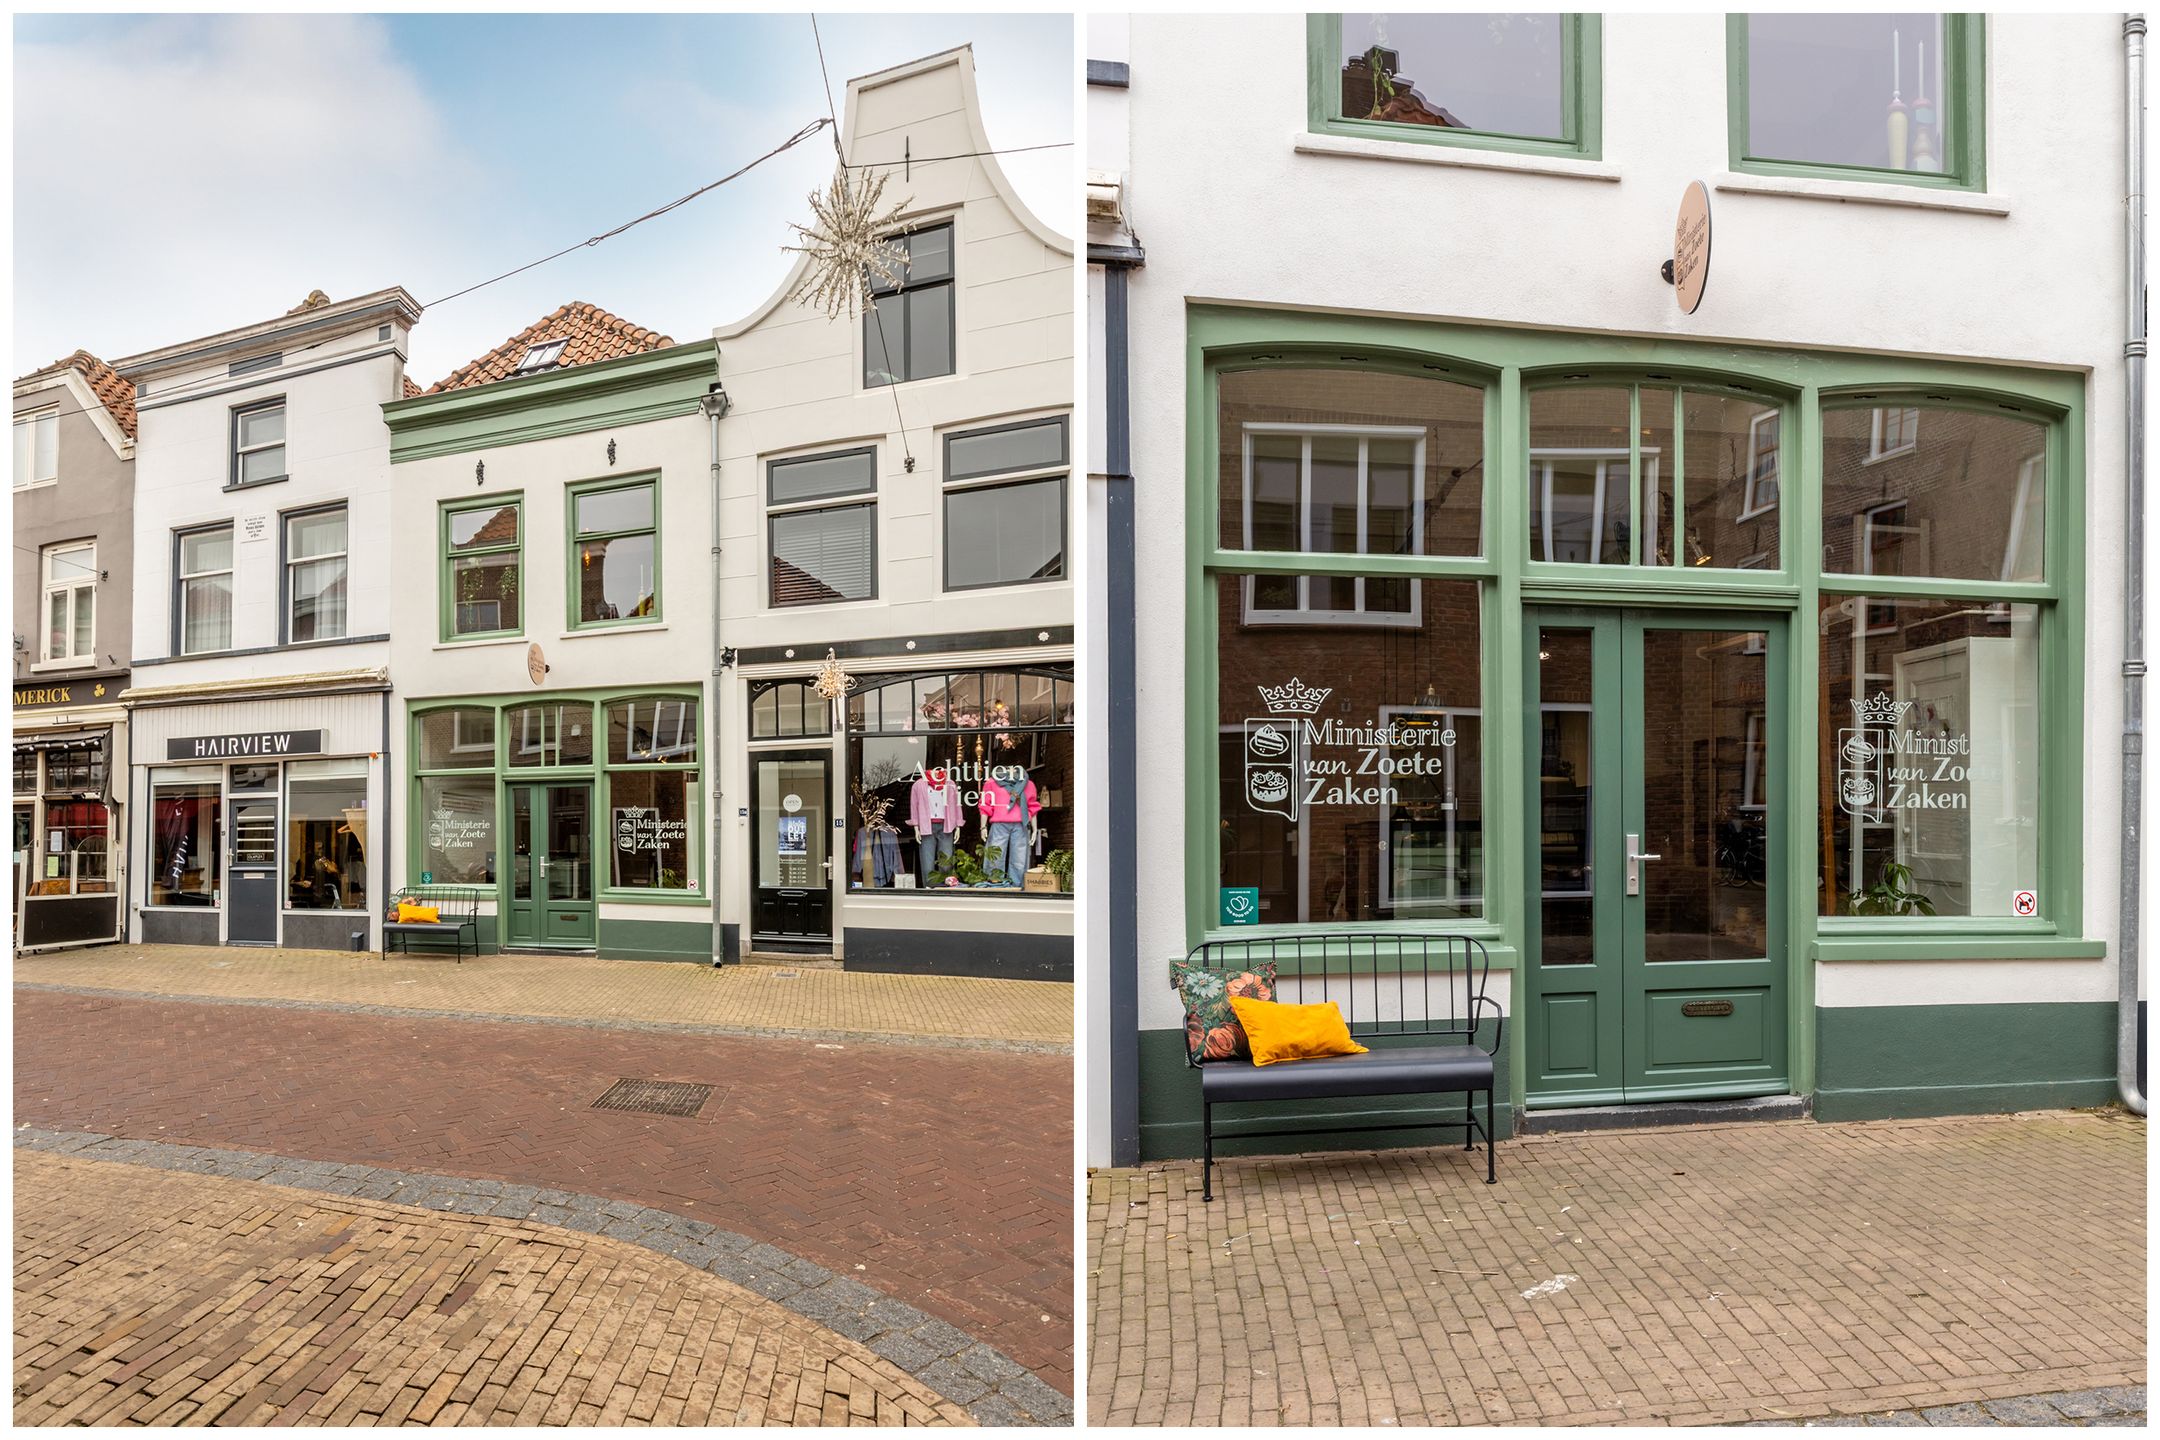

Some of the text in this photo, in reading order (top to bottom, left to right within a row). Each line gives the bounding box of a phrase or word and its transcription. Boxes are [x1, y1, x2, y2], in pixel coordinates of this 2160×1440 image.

[13, 687, 71, 706] MERICK
[1302, 718, 1457, 747] Ministerie
[1887, 729, 1970, 755] Minist
[195, 734, 291, 757] HAIRVIEW
[897, 758, 1025, 782] Achttien
[1303, 748, 1442, 775] van Zoete
[1887, 766, 1928, 781] van
[934, 784, 1010, 808] Tien
[1302, 777, 1398, 805] Zaken
[1886, 783, 1967, 809] Zaken
[445, 820, 491, 829] Ministerie
[460, 829, 486, 838] Zoete
[637, 819, 688, 829] Ministerie
[655, 829, 685, 839] Zoete
[445, 839, 473, 848] Zaken
[637, 839, 670, 849] Zaken
